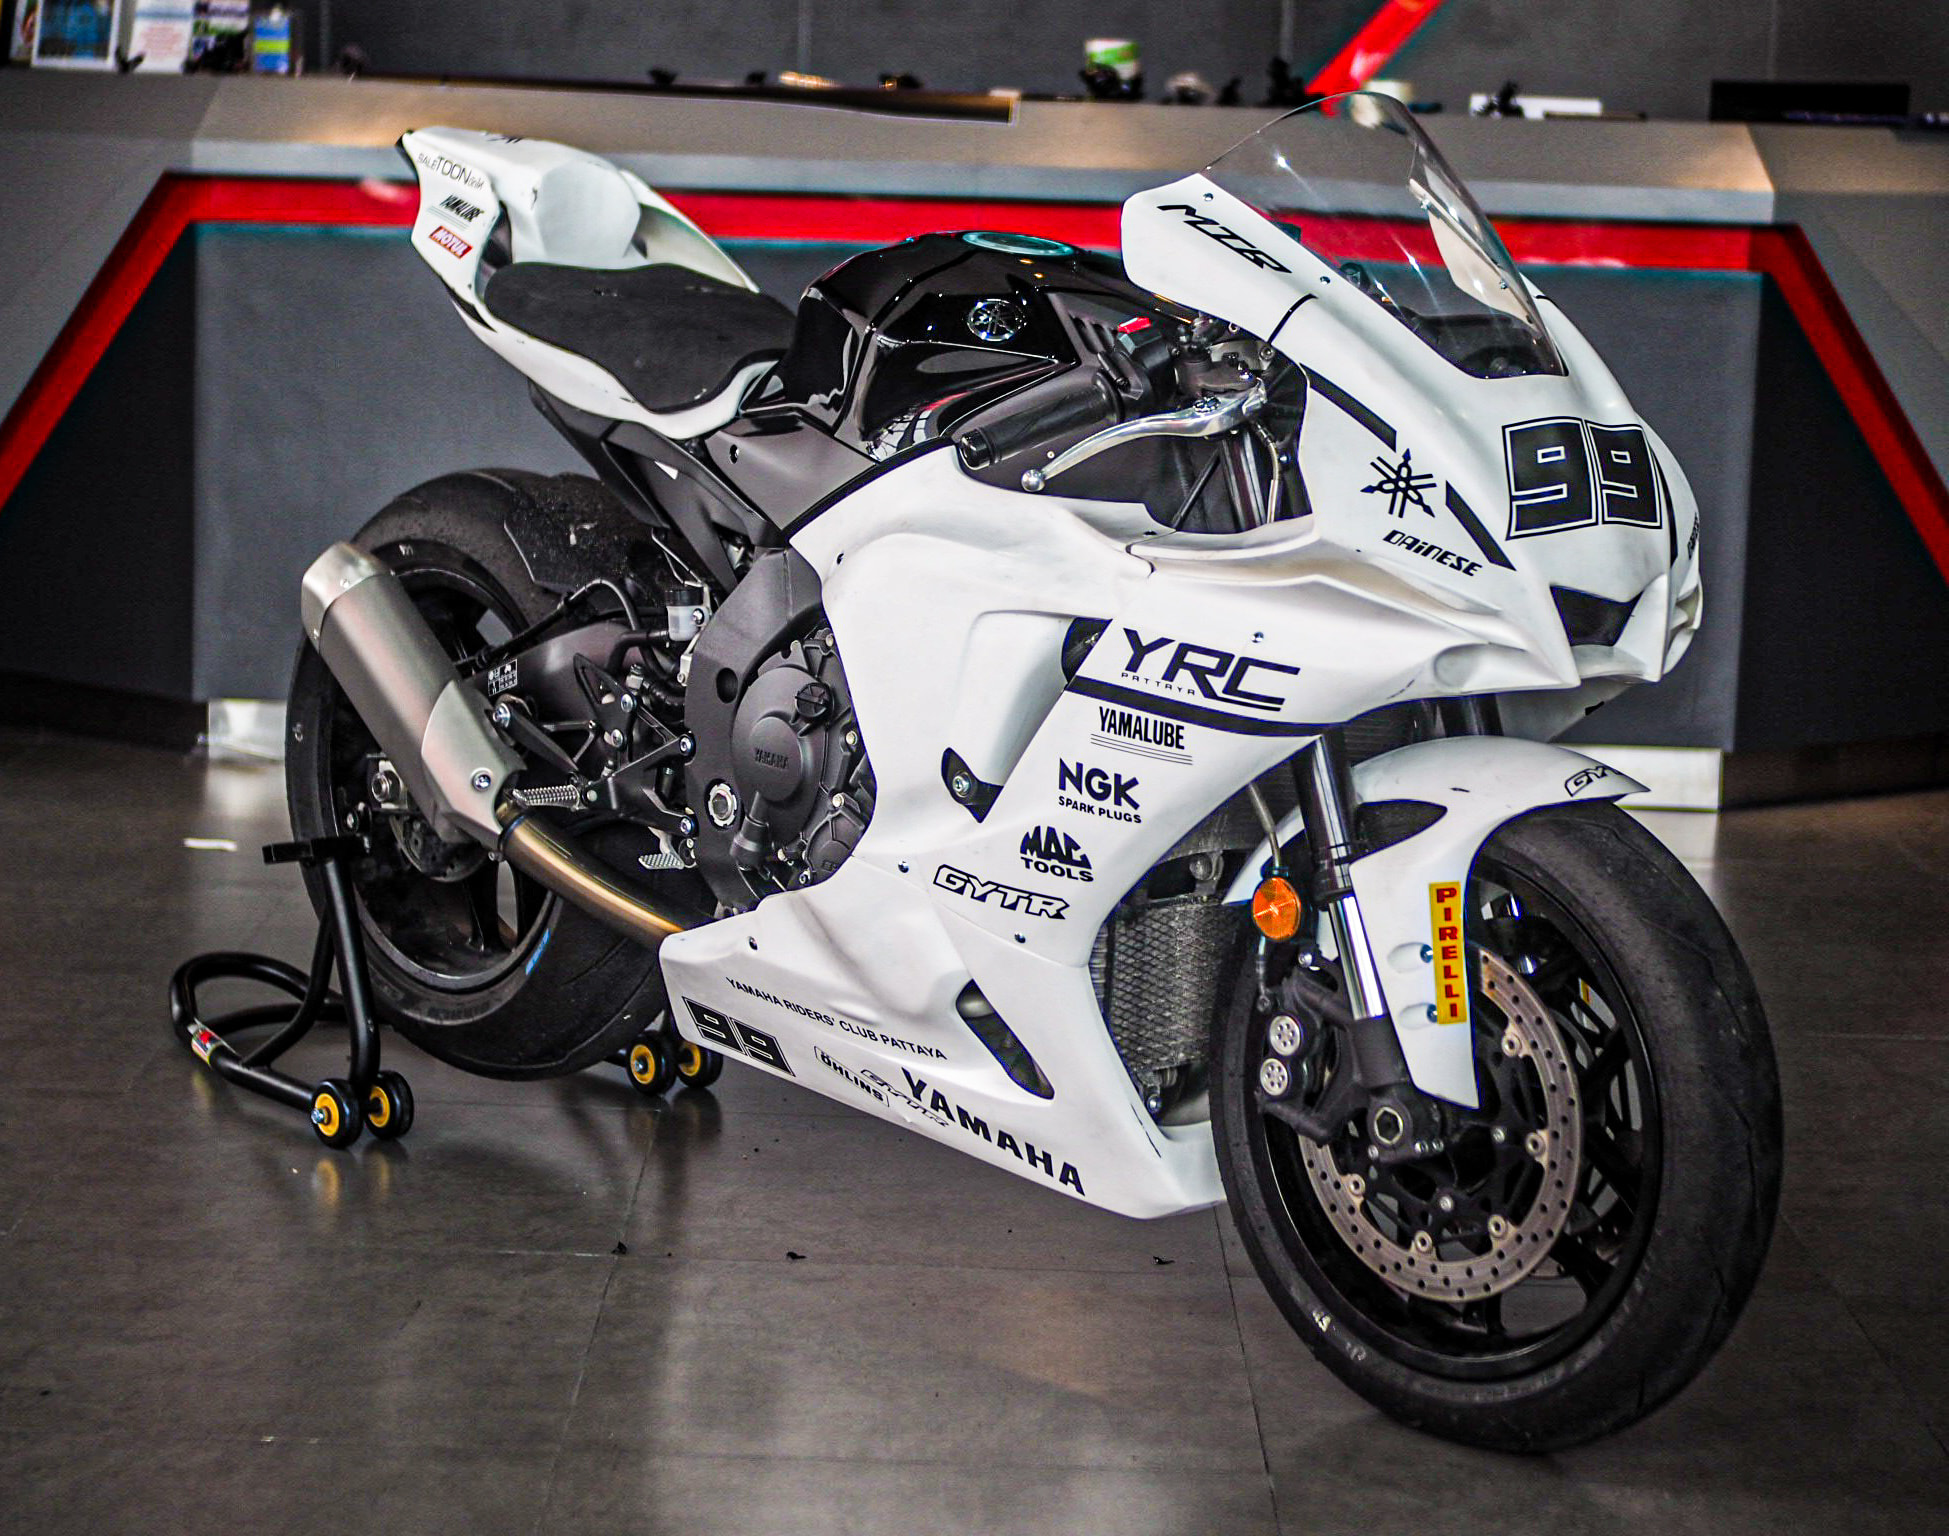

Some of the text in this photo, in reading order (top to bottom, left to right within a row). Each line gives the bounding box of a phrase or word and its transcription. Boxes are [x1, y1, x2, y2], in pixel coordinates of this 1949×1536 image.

[432, 227, 469, 257] MOTUL
[1502, 416, 1663, 541] 99
[1120, 671, 1196, 696] PATTAYA
[1122, 627, 1301, 712] YRC
[1099, 705, 1186, 750] YAMALUBE
[1058, 757, 1141, 811] NGK
[1058, 795, 1142, 824] SPARK PLUGS
[1019, 825, 1093, 870] MAC
[1020, 856, 1095, 883] TOOLS
[932, 863, 1070, 920] GYTR
[1436, 887, 1460, 1018] PIRELLI
[682, 995, 796, 1077] 99
[725, 976, 948, 1060] YAMAHA RIDERS' CLUB PATTAYA
[820, 1050, 884, 1102] ÖHLINS
[901, 1066, 1086, 1197] YAMAHA
